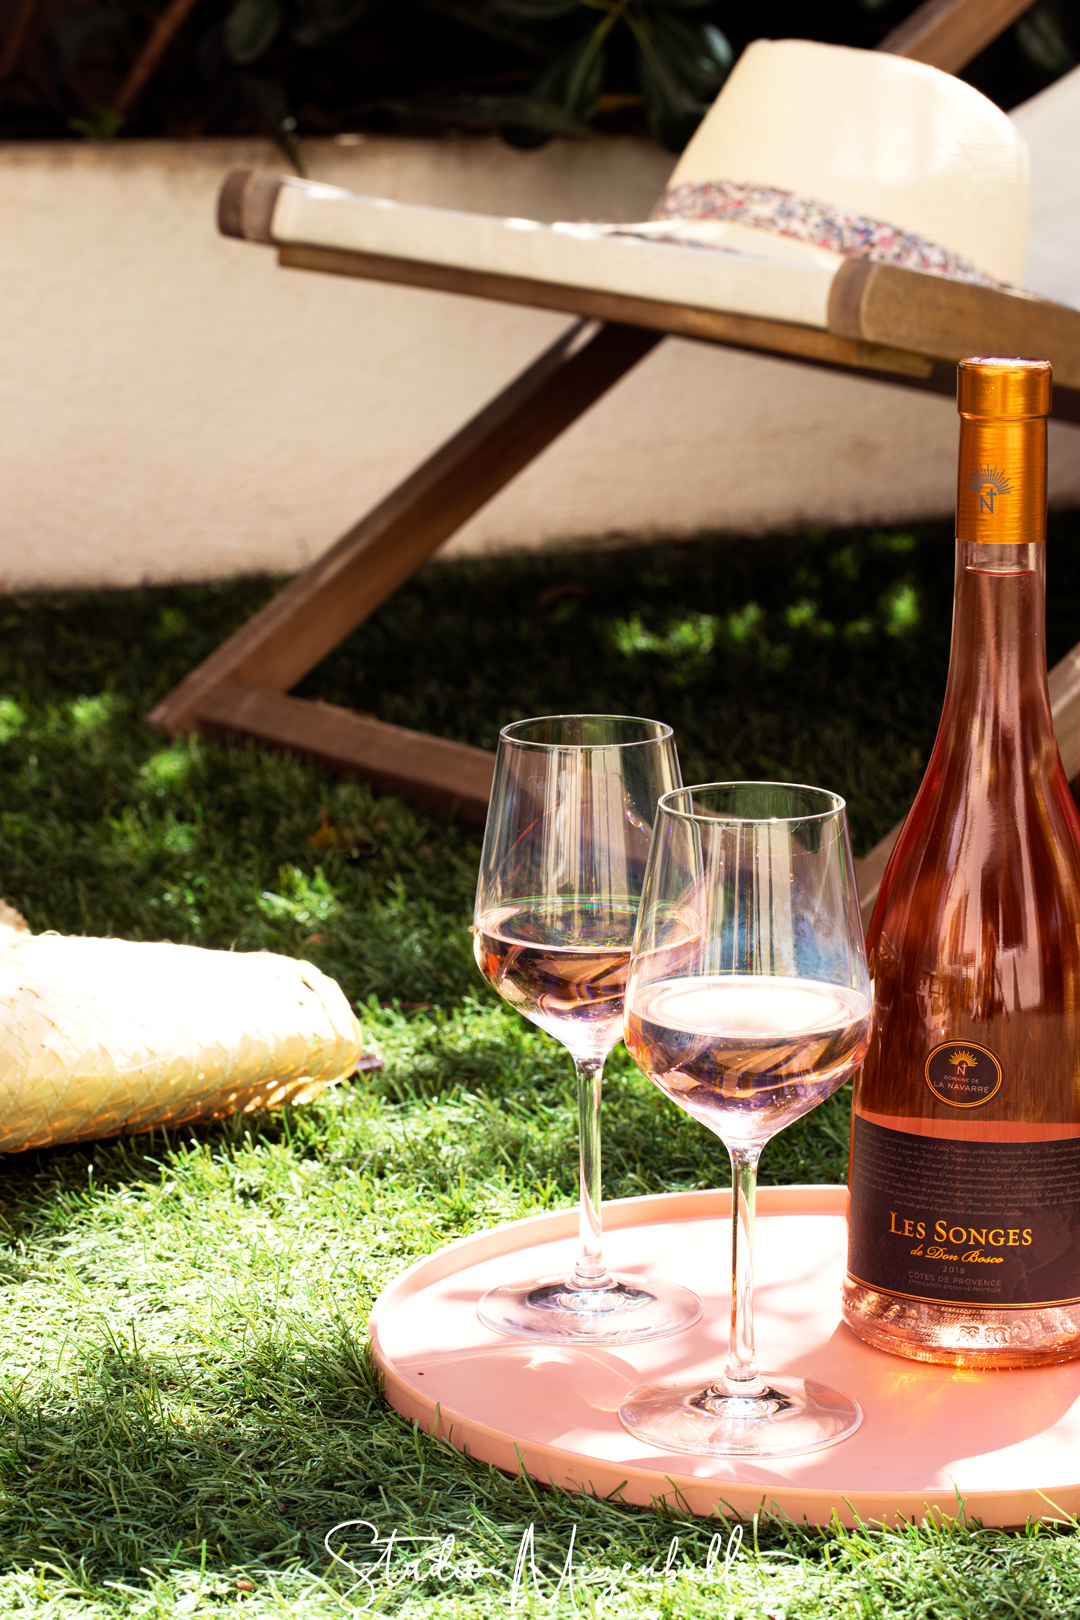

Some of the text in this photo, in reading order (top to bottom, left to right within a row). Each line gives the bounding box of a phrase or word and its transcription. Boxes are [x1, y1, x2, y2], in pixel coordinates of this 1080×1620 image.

[943, 1075, 969, 1083] DOMAINE
[933, 1080, 989, 1094] LA NAVARRE
[909, 1244, 1004, 1264] de Don Bosco
[942, 1265, 966, 1274] 2018
[908, 1271, 1002, 1287] CÔTES DE PROVENCE
